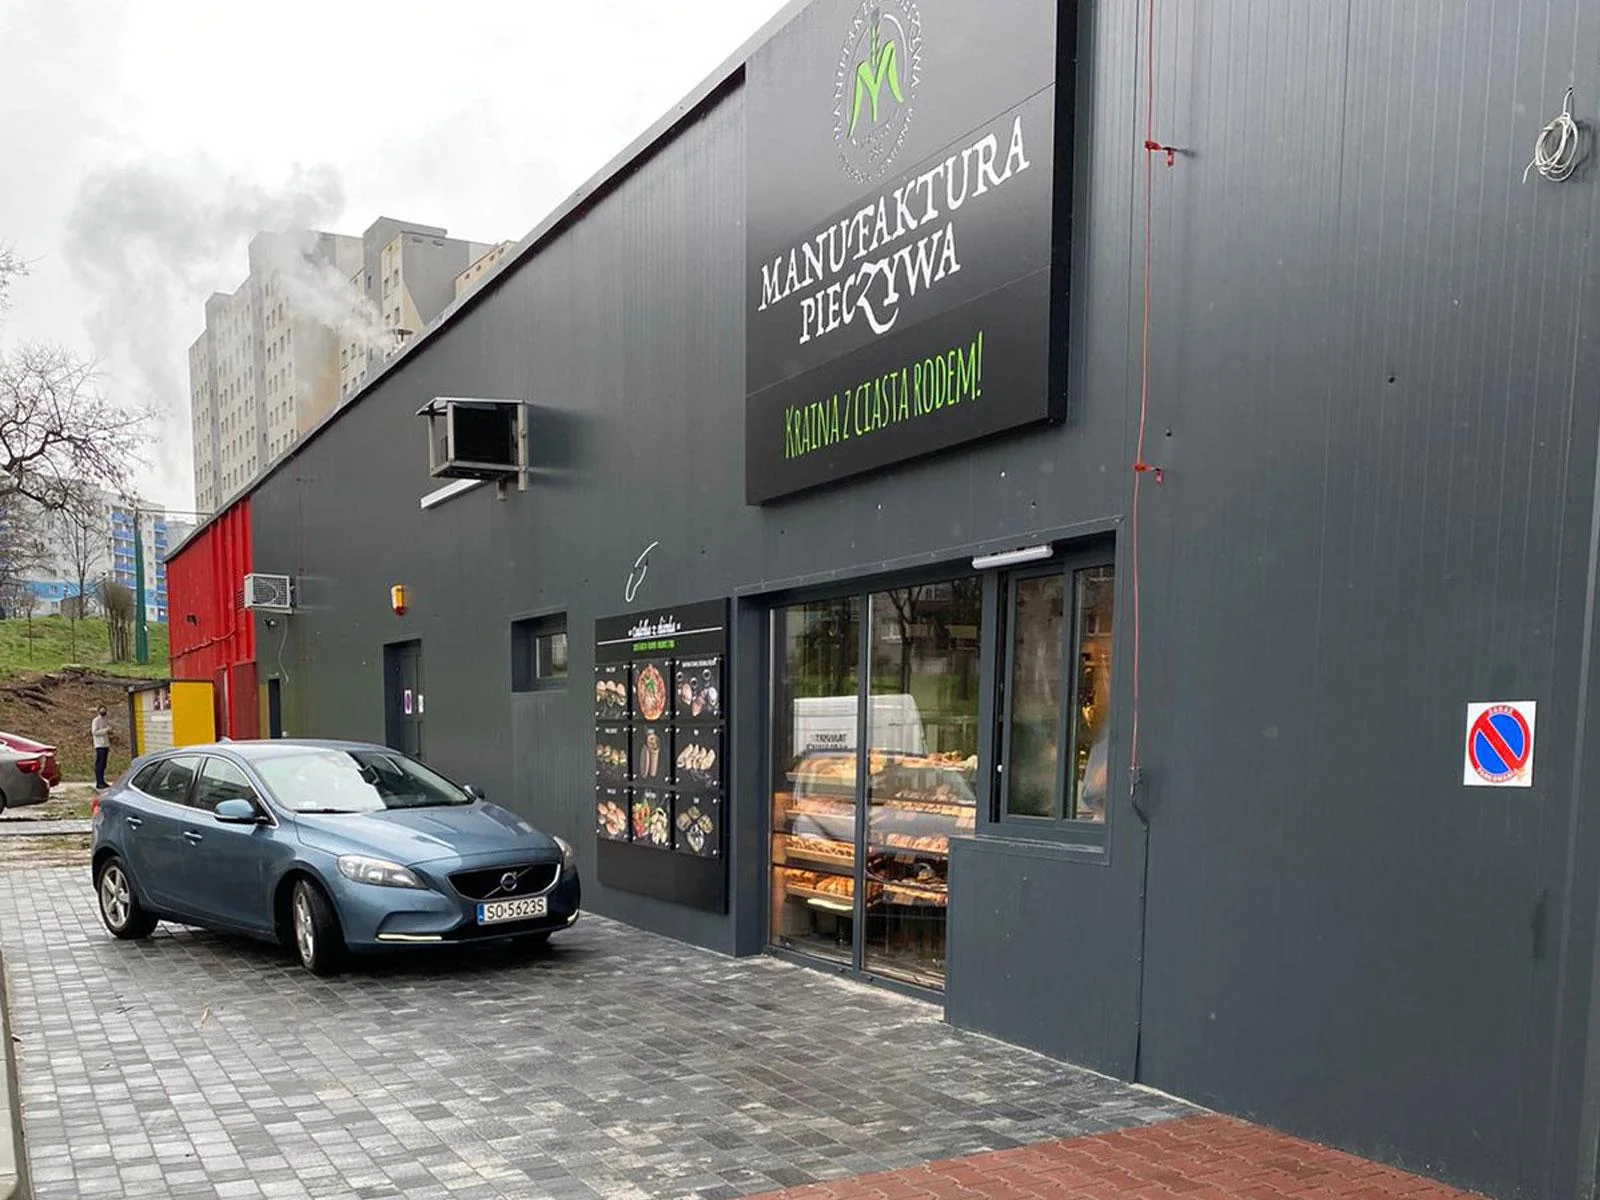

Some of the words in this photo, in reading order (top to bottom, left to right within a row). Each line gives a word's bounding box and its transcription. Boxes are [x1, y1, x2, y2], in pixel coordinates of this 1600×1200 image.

[758, 116, 1030, 312] MANUFAKTURA
[799, 221, 961, 344] PIECZYWA
[854, 368, 909, 437] CIASTA
[914, 331, 983, 417] RODEM!
